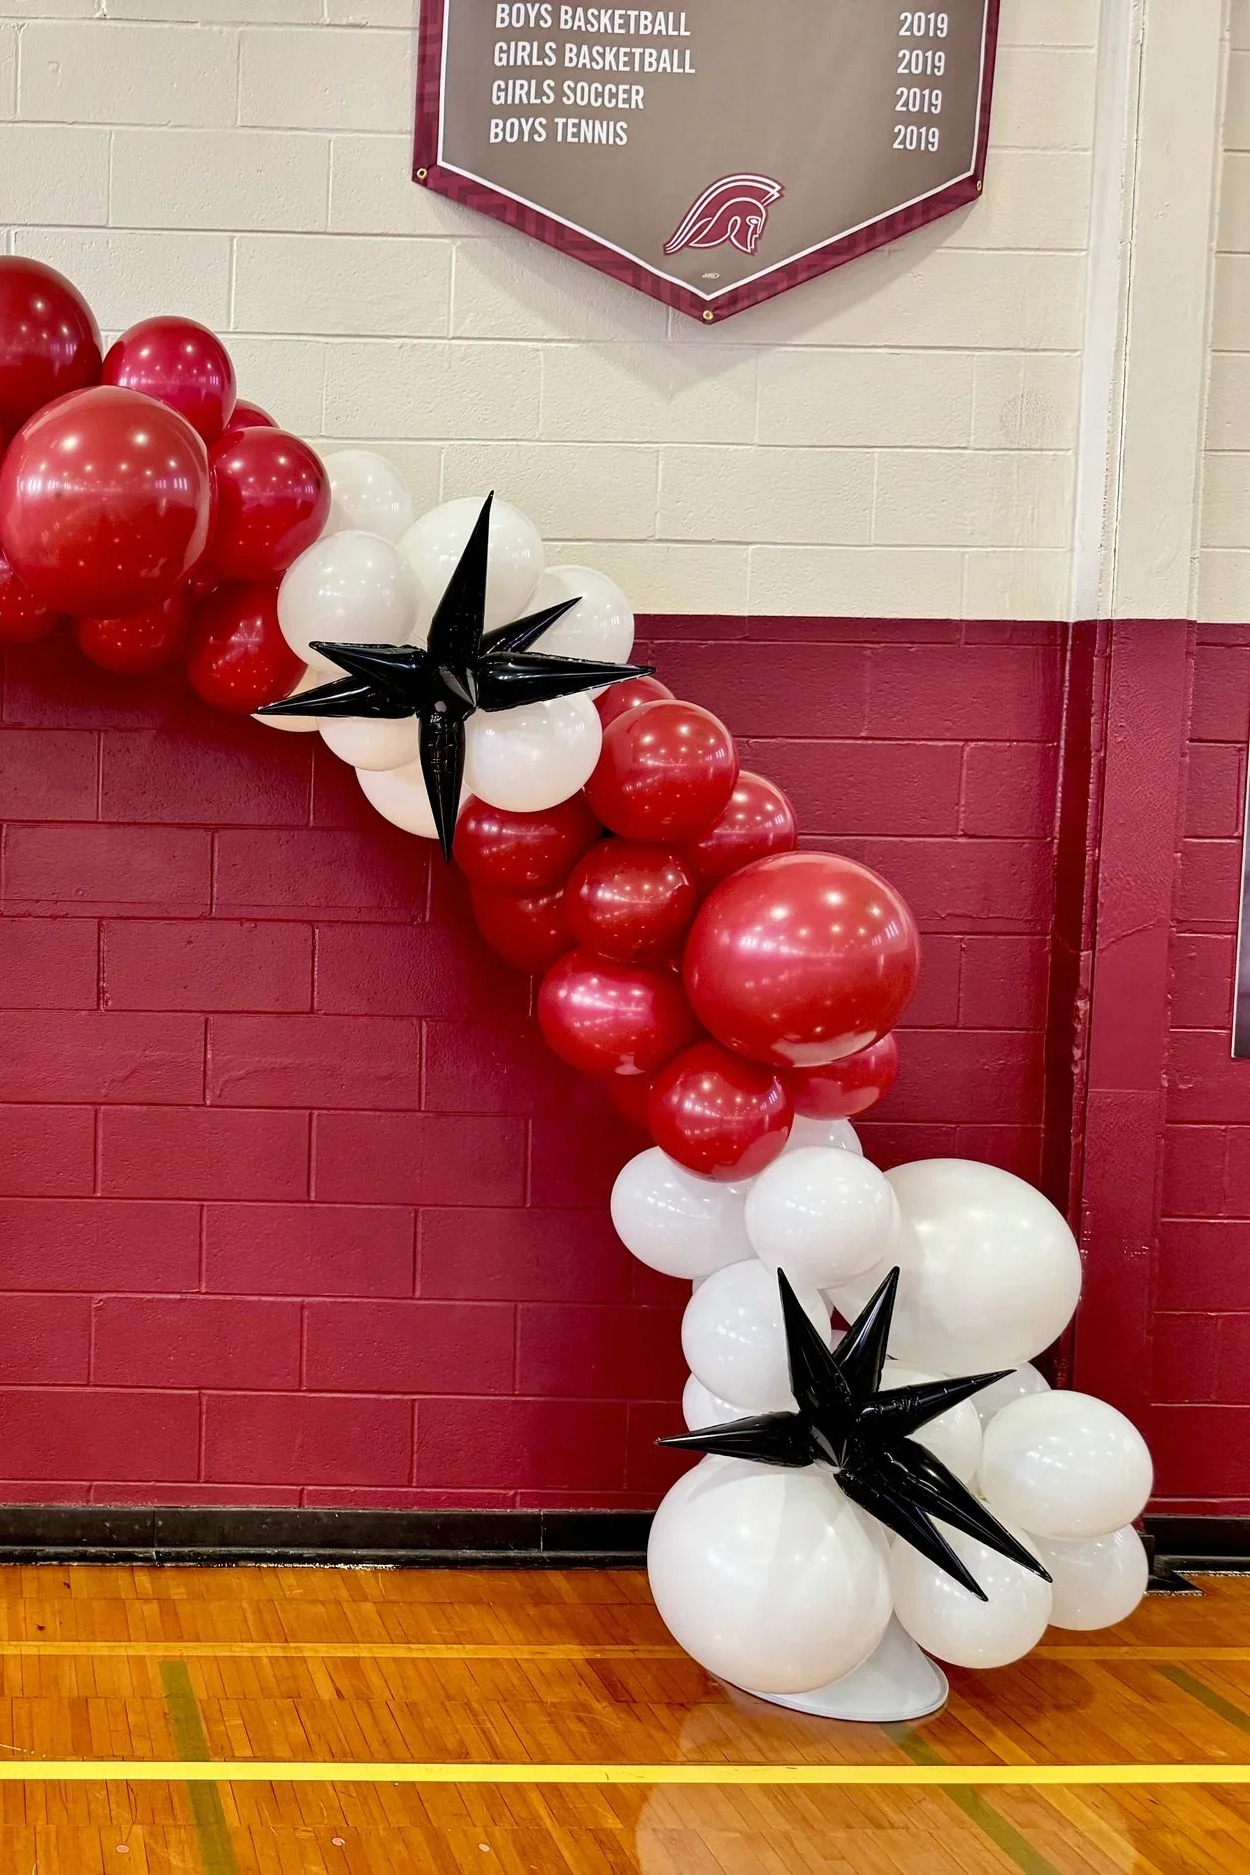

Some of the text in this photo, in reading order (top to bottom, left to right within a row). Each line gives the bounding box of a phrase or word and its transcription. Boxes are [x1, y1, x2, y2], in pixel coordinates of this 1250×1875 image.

[495, 2, 691, 37] BOYS BASKETBALL
[898, 11, 948, 39] 2019
[493, 40, 696, 75] GIRLS BASKETBALL
[896, 48, 946, 77] 2019
[491, 78, 645, 110] GIRLS SOCCER
[894, 86, 943, 115] 2019
[489, 116, 628, 147] BOYS TENNIS
[892, 123, 940, 152] 2019
